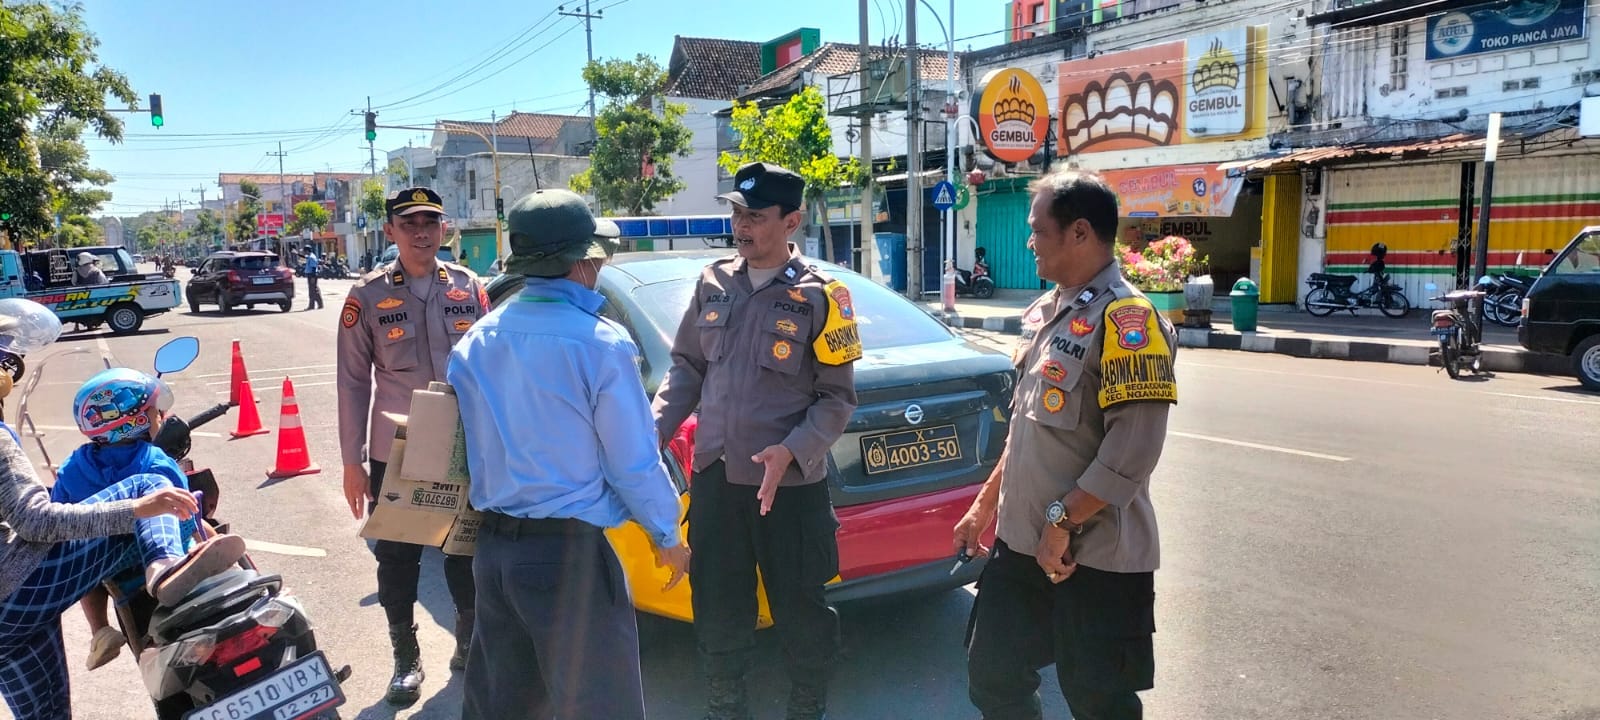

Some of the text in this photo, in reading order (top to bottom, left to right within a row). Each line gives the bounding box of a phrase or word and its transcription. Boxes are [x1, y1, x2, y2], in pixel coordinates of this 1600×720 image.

[1437, 25, 1469, 38] AQUA
[1481, 25, 1579, 48] TOKO PANCA JAYA
[1189, 95, 1242, 113] GEMBUL
[991, 130, 1036, 142] GEMBUL
[1119, 170, 1179, 194] GEMBUL
[1194, 182, 1205, 192] 14
[444, 305, 476, 316] POLRI
[774, 300, 811, 316] POLRI
[379, 311, 408, 326] RUDI
[1050, 336, 1086, 361] POLRI
[915, 430, 925, 442] X
[890, 439, 957, 467] 4003-50
[227, 685, 280, 720] 6510
